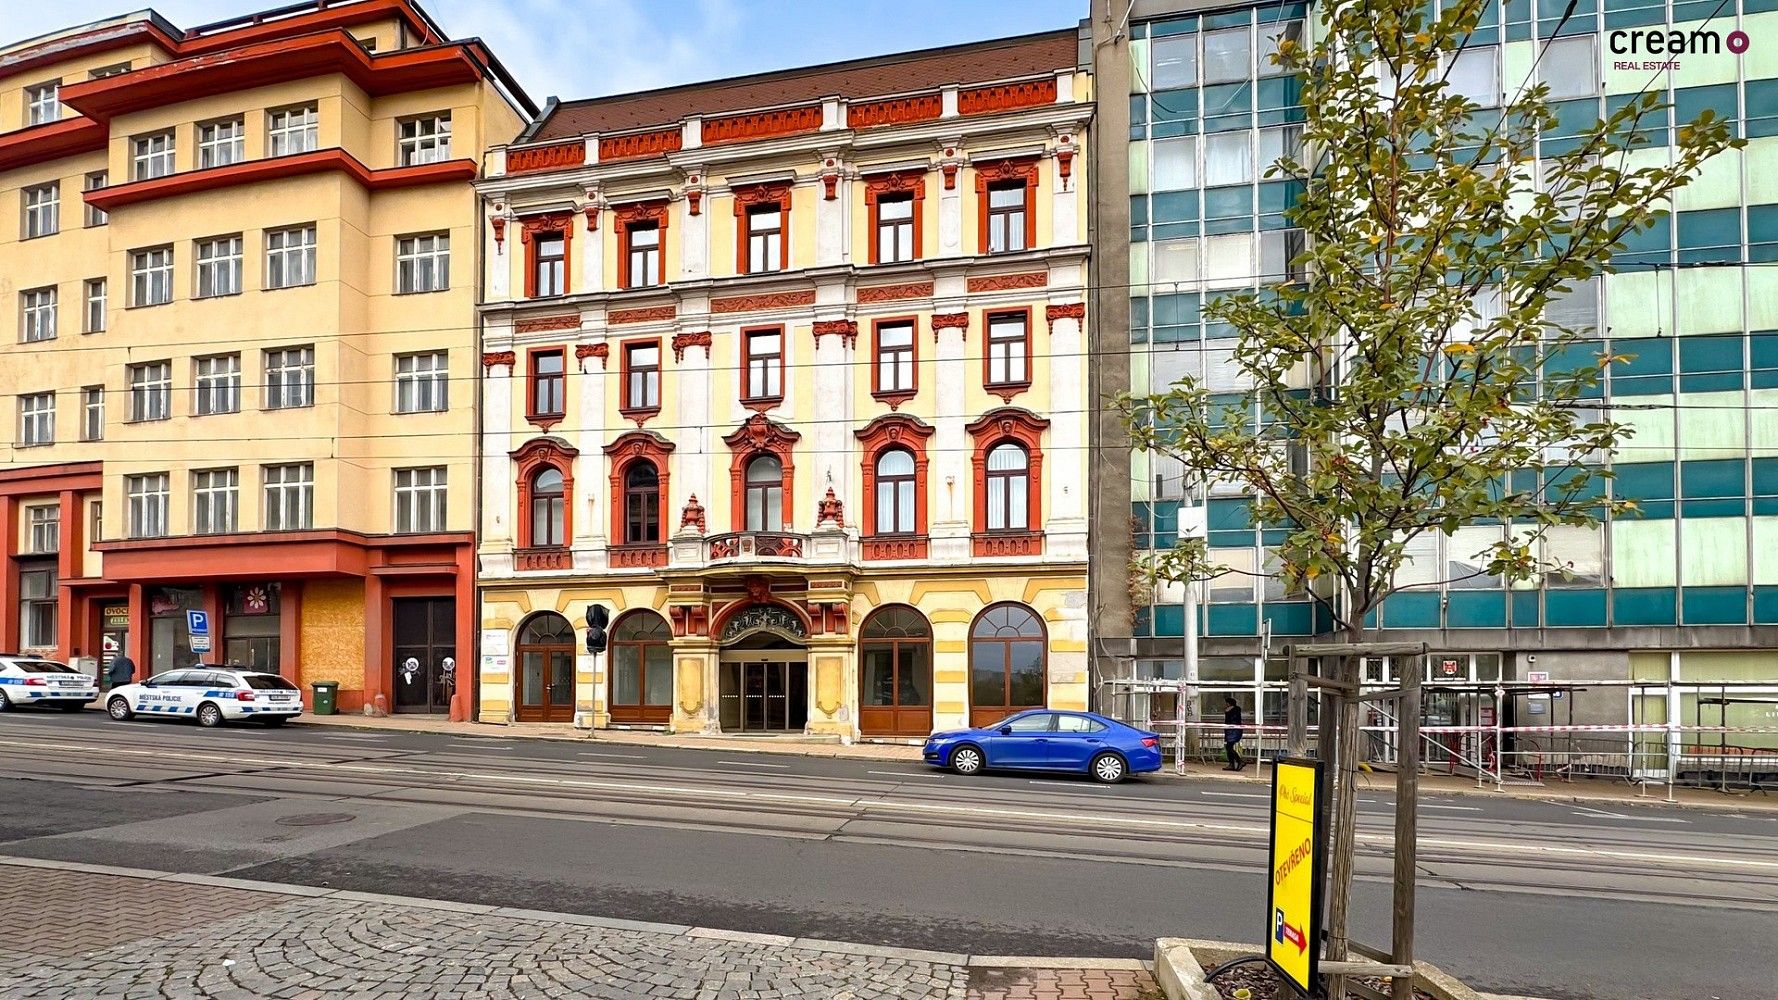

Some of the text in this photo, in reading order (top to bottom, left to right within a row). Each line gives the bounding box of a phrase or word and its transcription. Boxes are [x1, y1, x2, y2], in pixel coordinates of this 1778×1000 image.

[192, 613, 204, 628] P
[1275, 837, 1312, 886] OTEVŘENO
[1276, 911, 1283, 932] P
